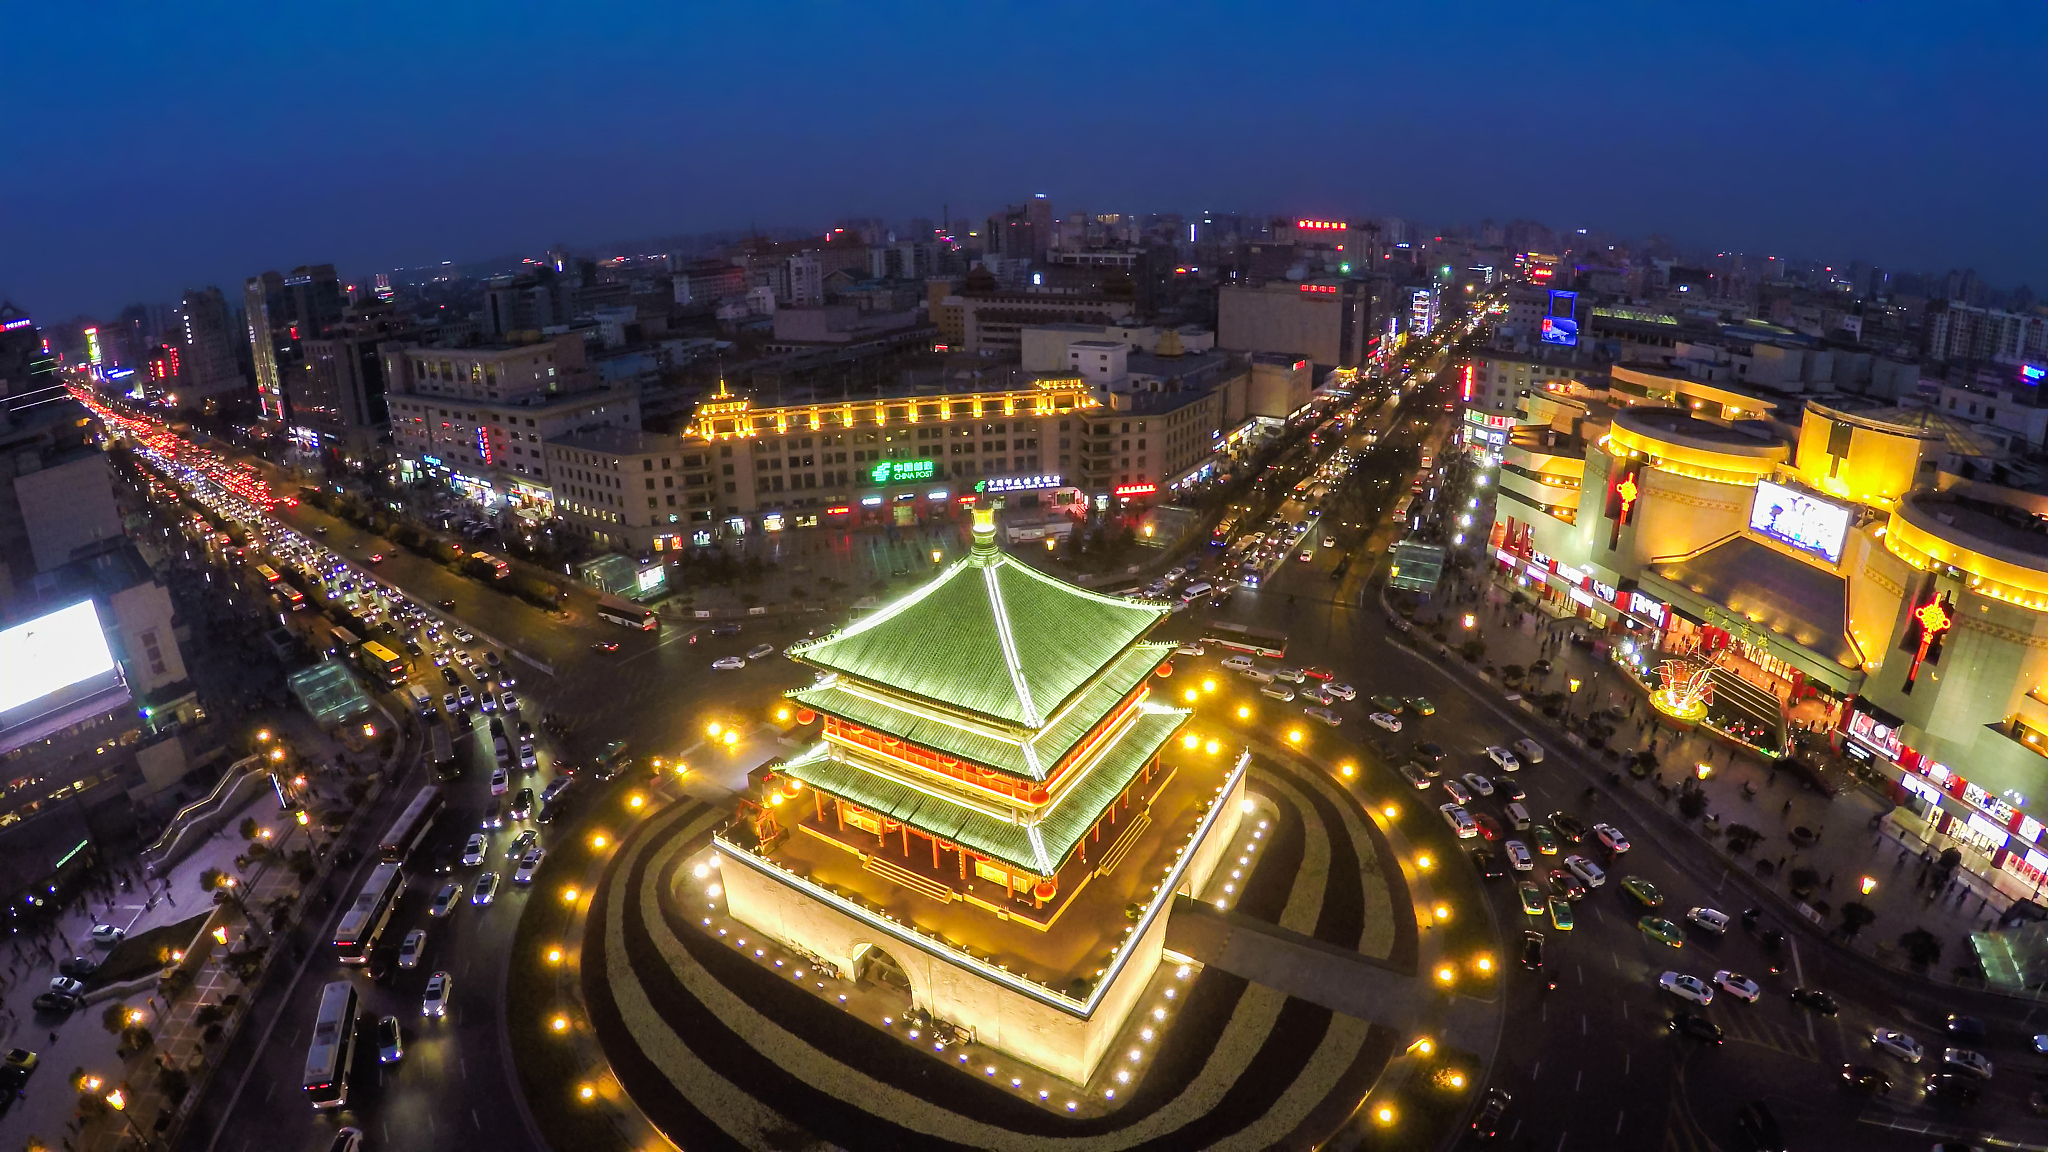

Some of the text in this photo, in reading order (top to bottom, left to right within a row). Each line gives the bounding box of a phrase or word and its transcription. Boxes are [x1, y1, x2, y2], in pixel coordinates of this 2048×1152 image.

[893, 461, 933, 473] 中国邮政
[894, 470, 933, 480] CHINA POST
